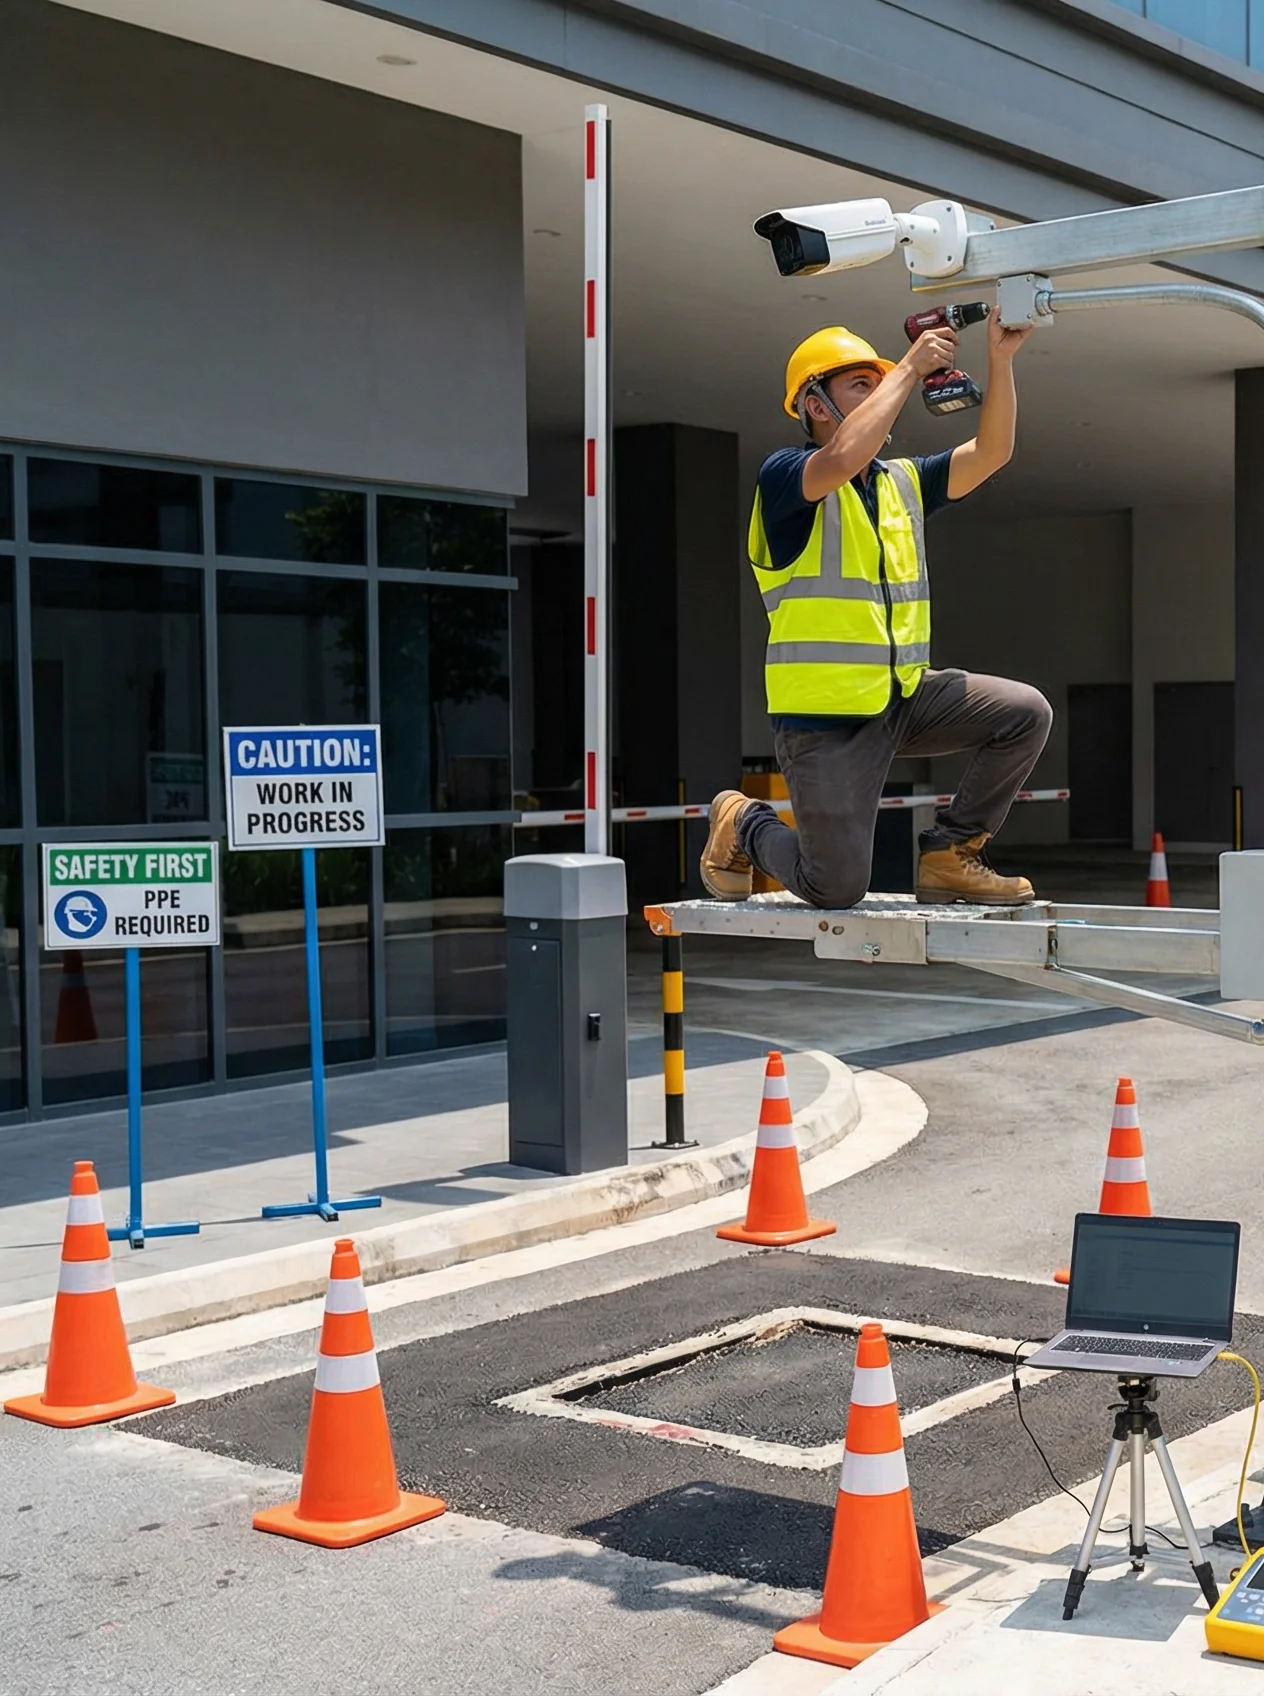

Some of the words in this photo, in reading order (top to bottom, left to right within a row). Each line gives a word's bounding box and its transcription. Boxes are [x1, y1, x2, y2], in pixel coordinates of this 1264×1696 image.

[237, 738, 371, 769] CAUTION:
[256, 781, 323, 805] WORK
[331, 781, 353, 803] IN
[247, 810, 365, 834] PROGRESS
[54, 854, 139, 880] SAFETY
[145, 853, 207, 878] FIRST
[144, 889, 180, 909] PPE
[115, 914, 209, 937] REQUIRED
